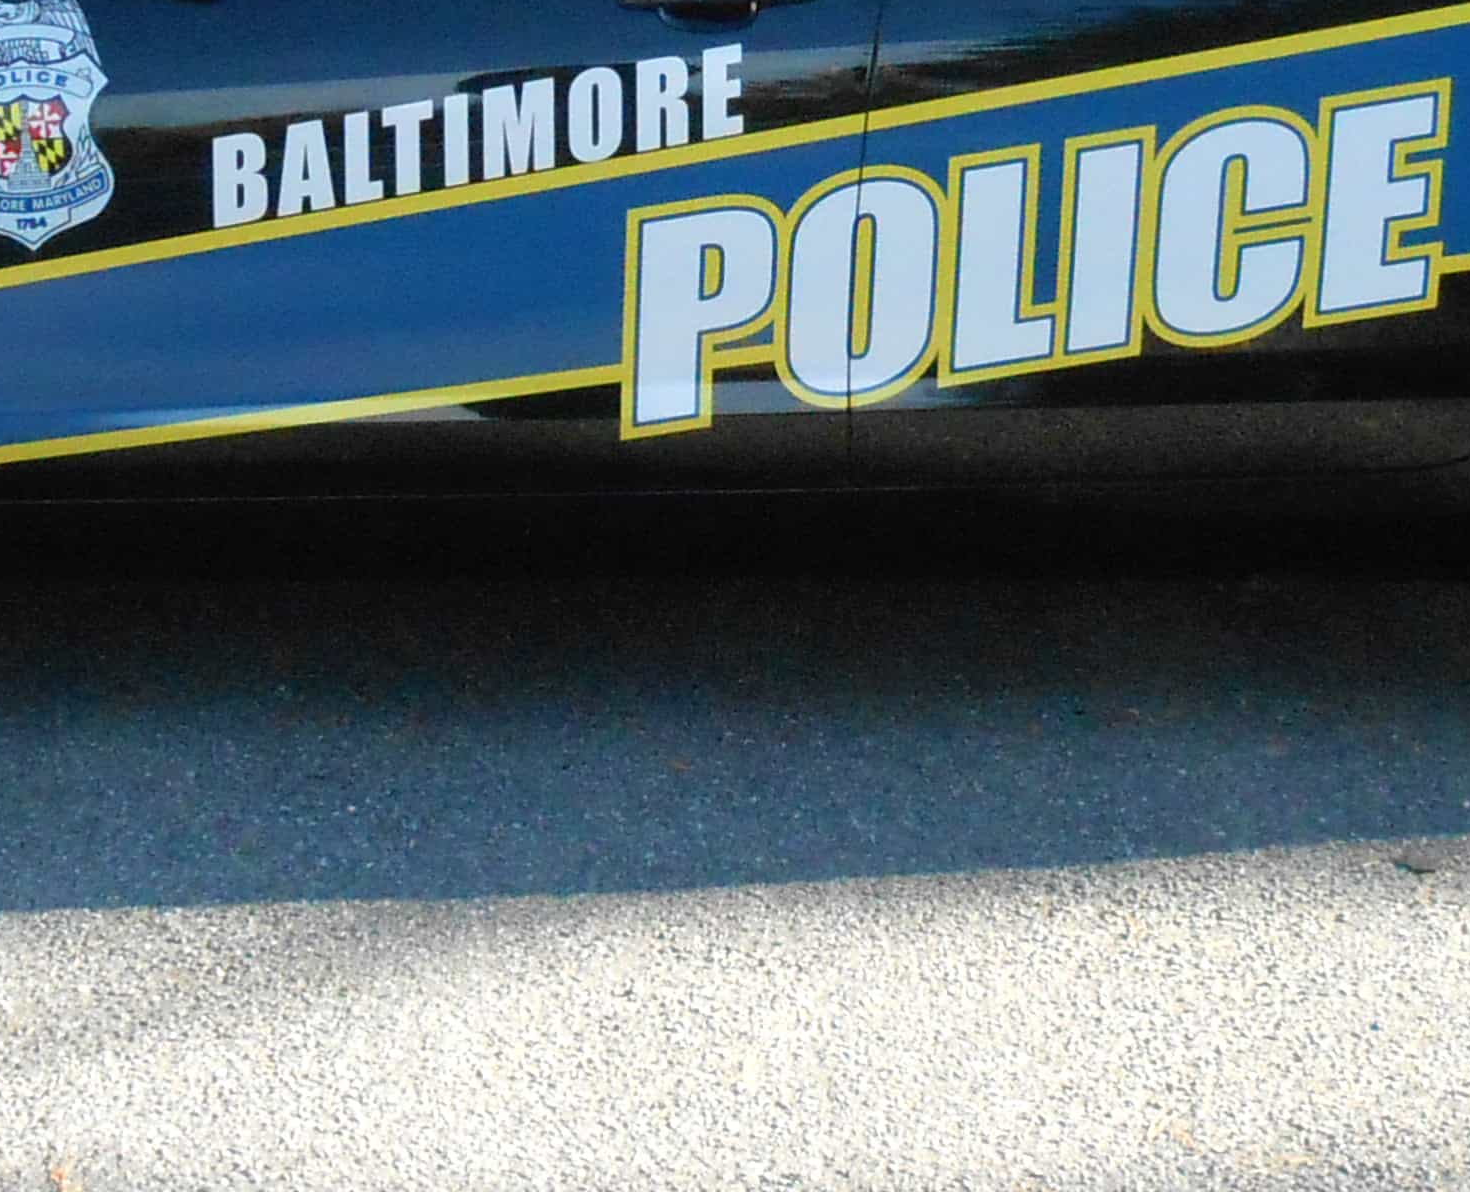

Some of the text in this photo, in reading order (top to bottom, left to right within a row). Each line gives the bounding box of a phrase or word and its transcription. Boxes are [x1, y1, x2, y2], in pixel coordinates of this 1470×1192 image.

[32, 178, 102, 209] MARYLAND
[212, 43, 744, 228] BALTIMORE
[621, 78, 1451, 438] POLICE
